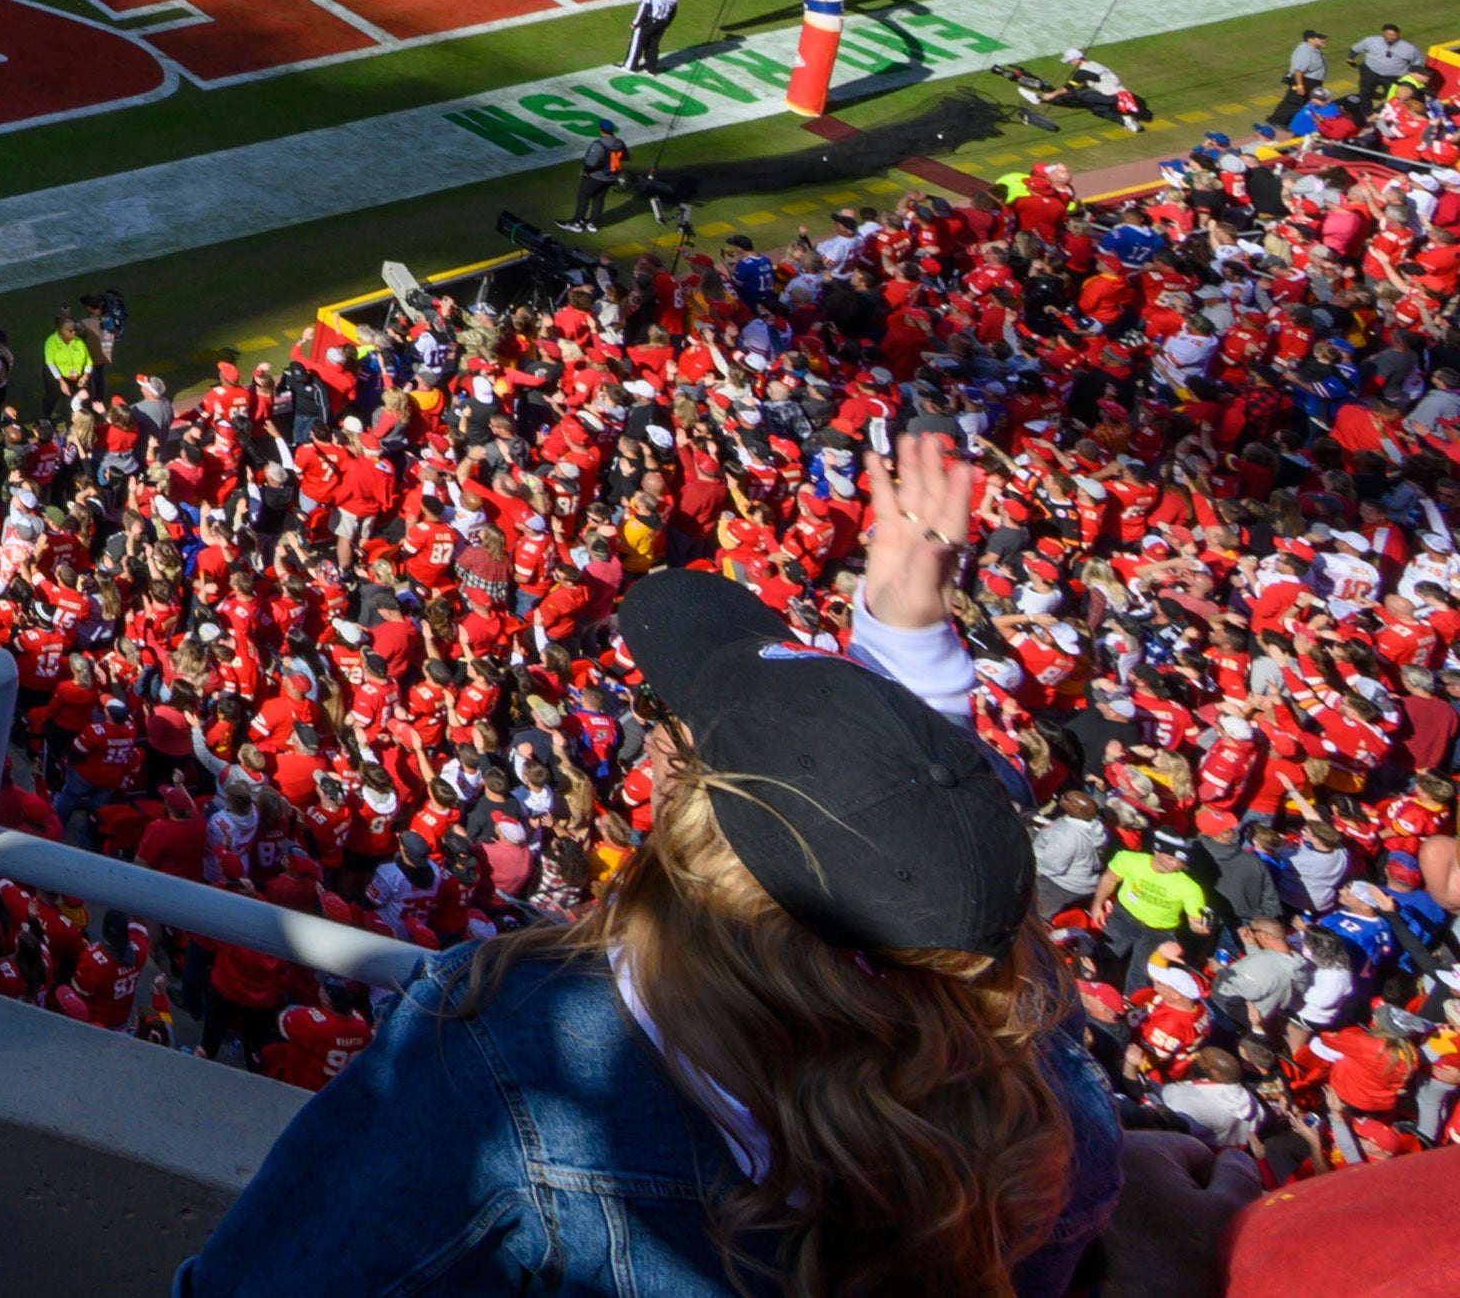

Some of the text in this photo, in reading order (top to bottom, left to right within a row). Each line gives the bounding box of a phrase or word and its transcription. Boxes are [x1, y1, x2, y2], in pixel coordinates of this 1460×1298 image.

[442, 13, 1014, 156] END RACISM
[1126, 244, 1151, 264] 17
